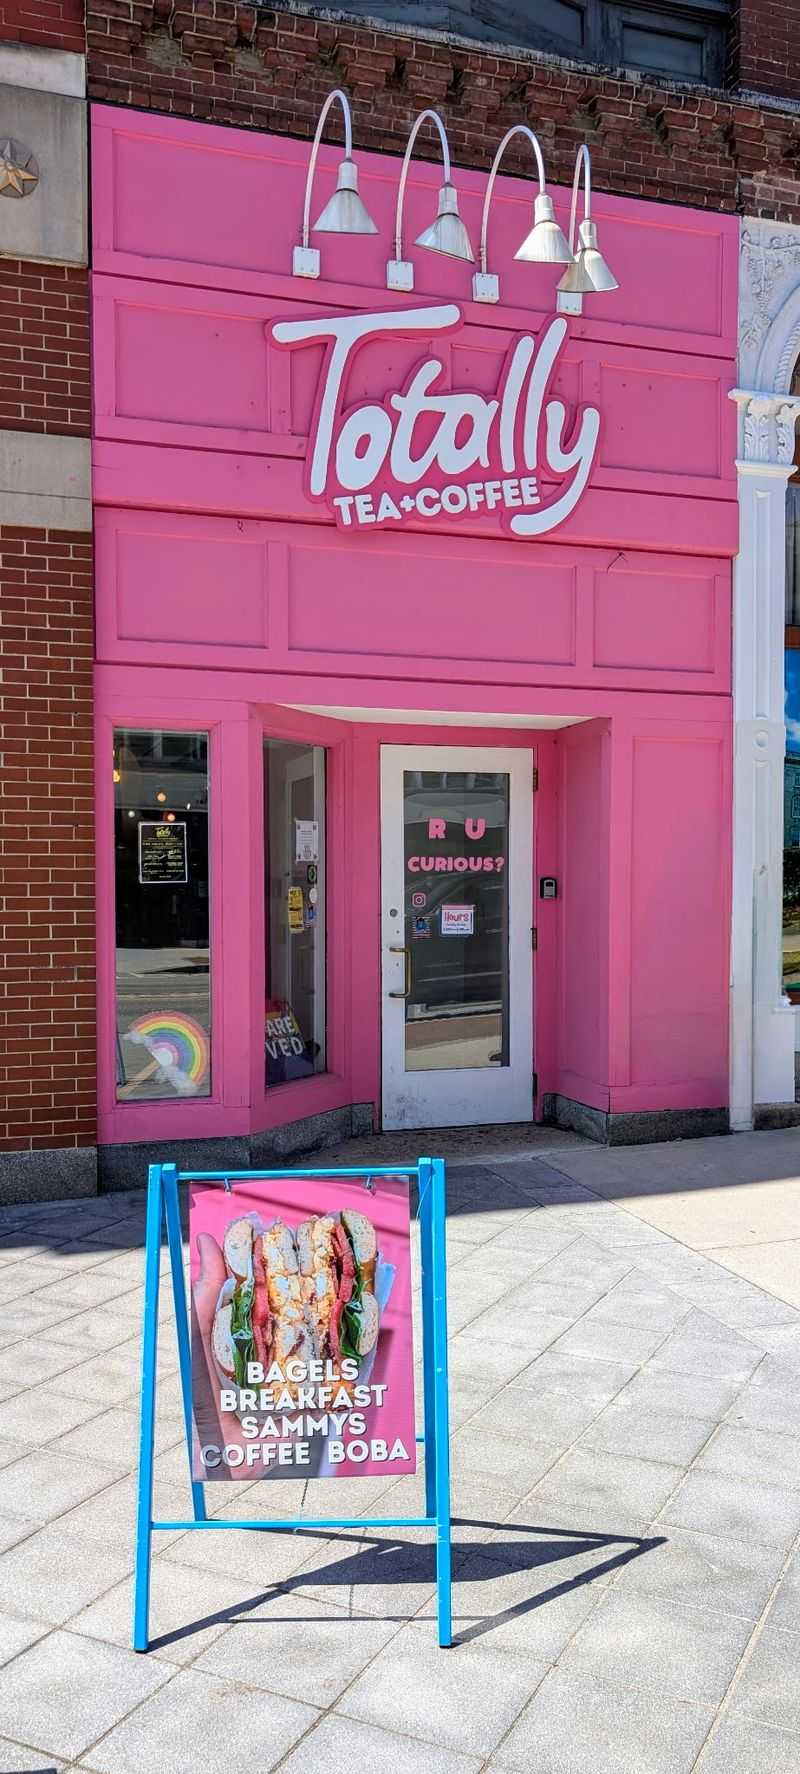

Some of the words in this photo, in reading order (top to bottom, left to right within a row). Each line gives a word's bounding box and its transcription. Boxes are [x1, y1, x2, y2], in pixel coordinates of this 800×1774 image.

[272, 304, 600, 536] Totally
[428, 817, 447, 839] R
[464, 817, 486, 840] U
[407, 856, 505, 872] CURIOUS?
[444, 911, 470, 922] Hours
[266, 1016, 295, 1037] ARE
[247, 1359, 359, 1384] BAGELS
[220, 1385, 388, 1412] BREAKFAST
[242, 1413, 367, 1439] SAMMYS
[200, 1441, 311, 1468] COFFEE
[328, 1438, 410, 1464] BOBA
